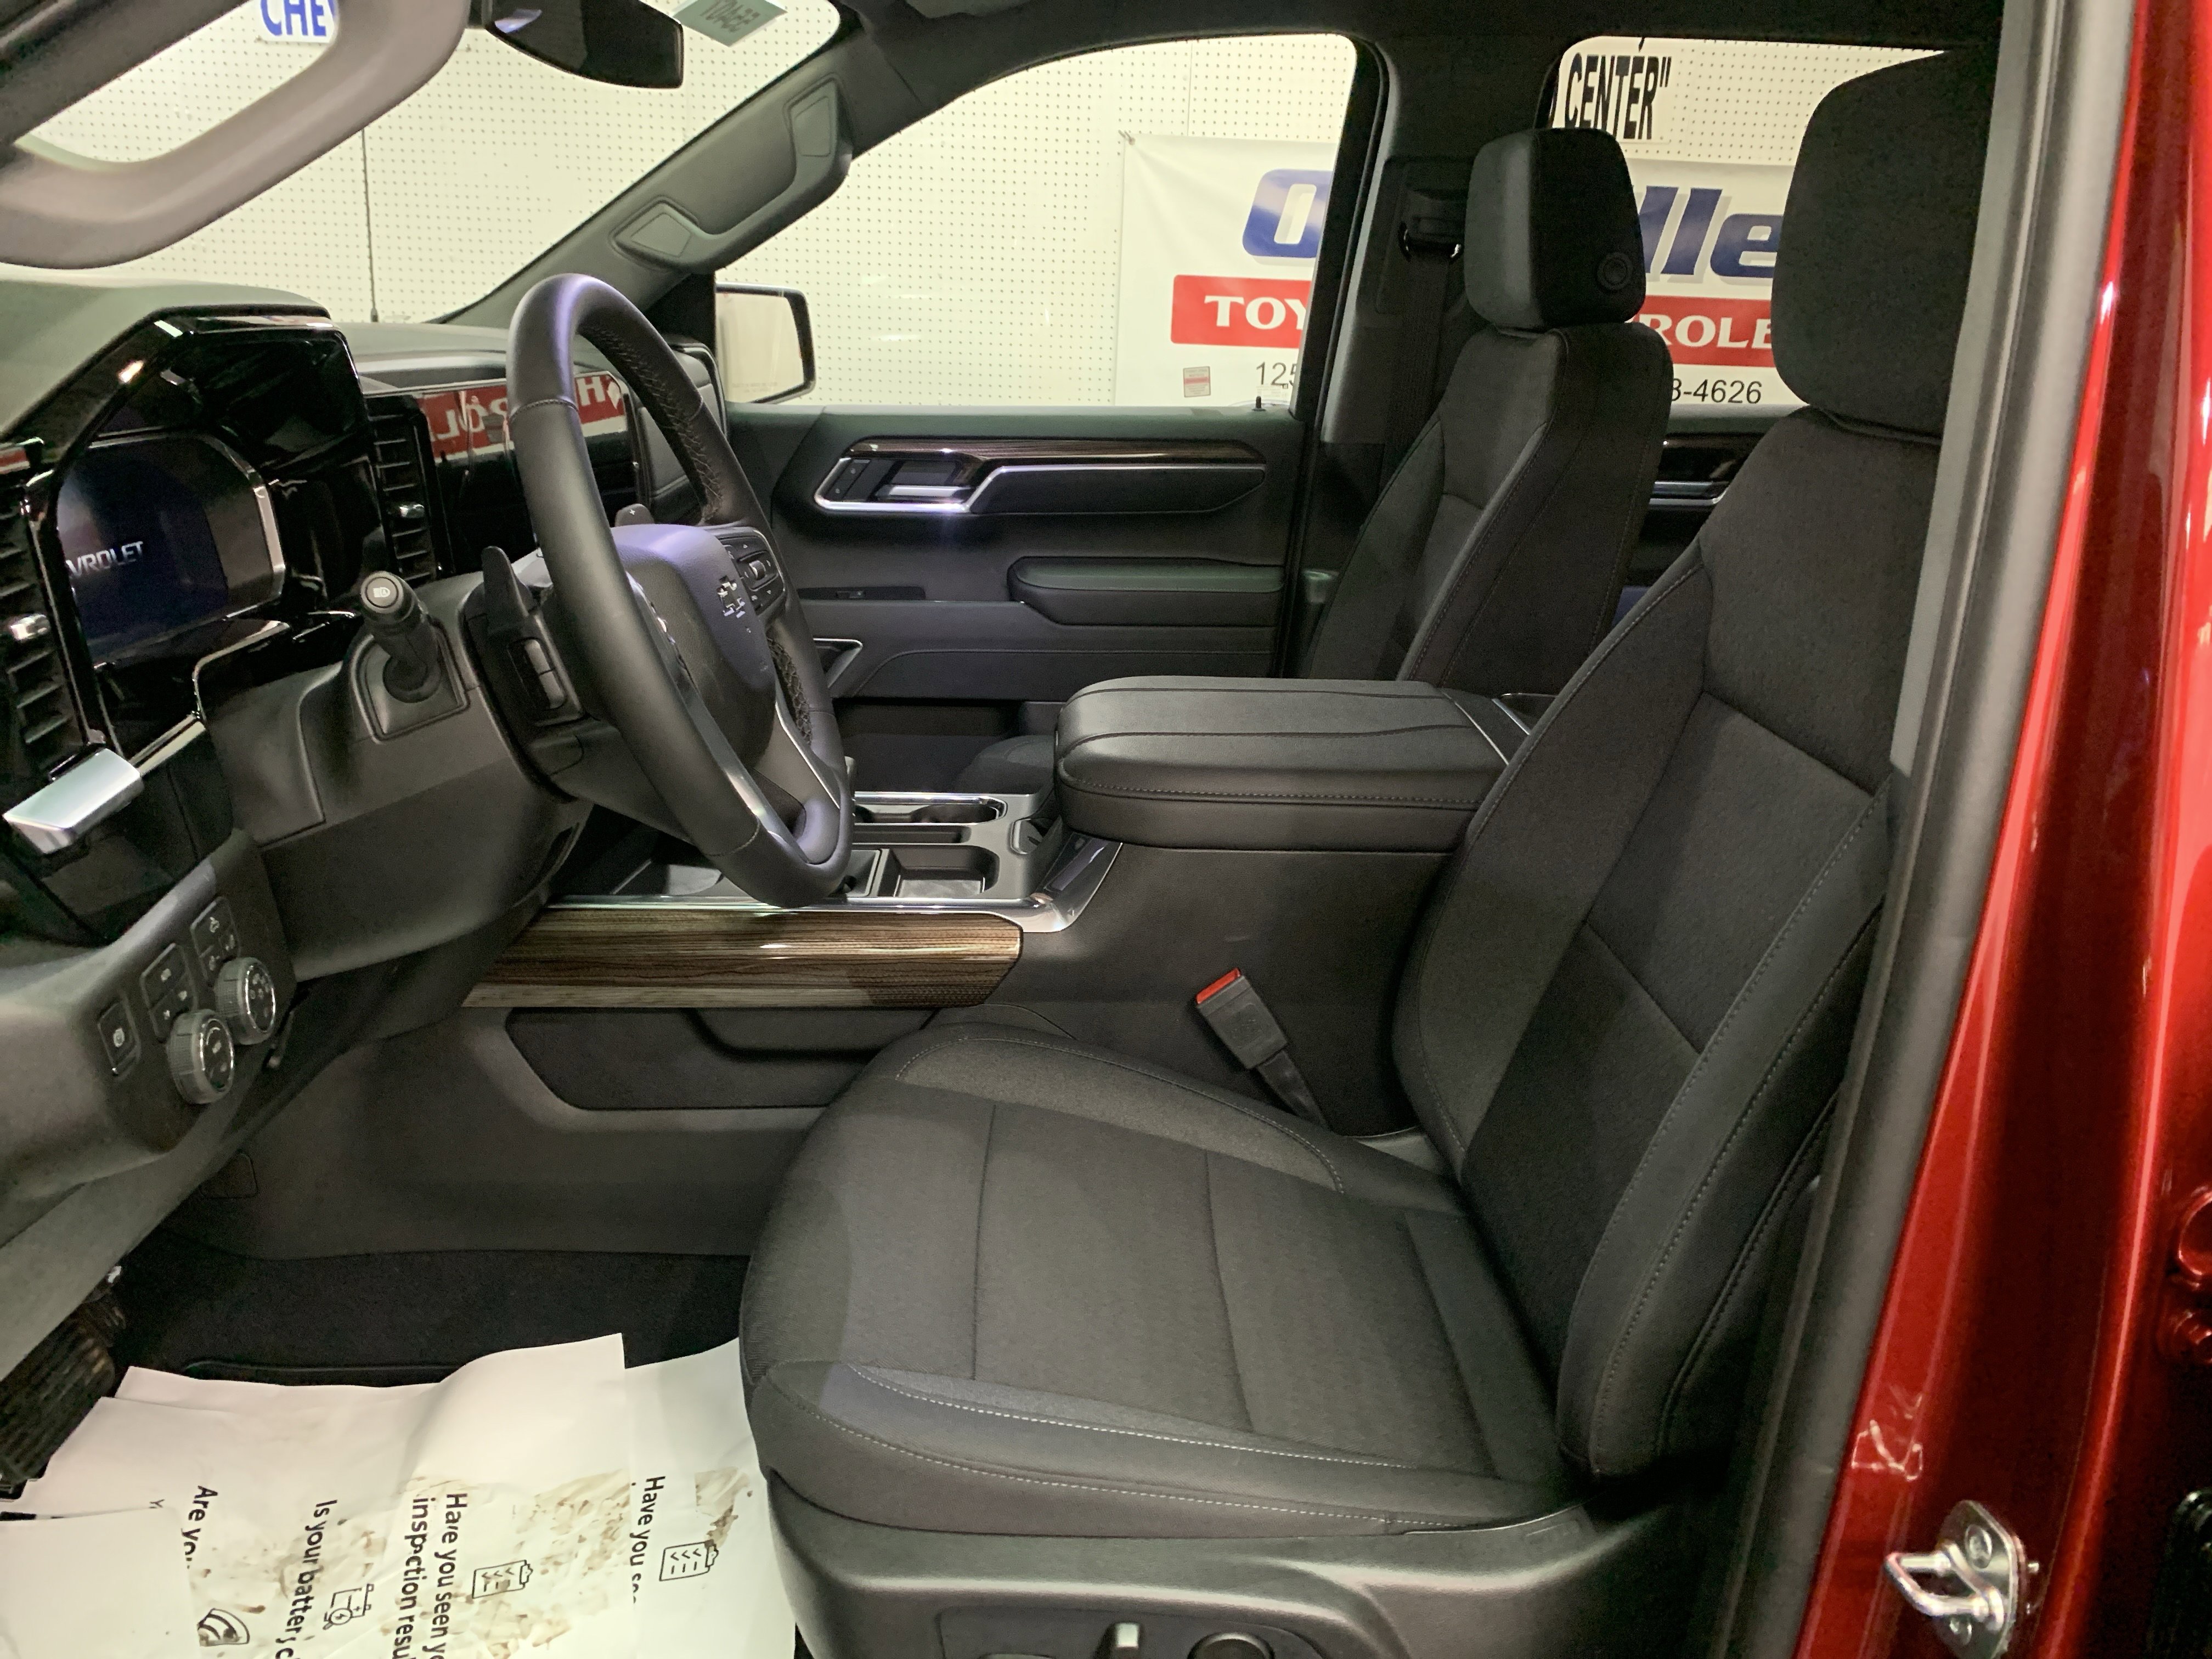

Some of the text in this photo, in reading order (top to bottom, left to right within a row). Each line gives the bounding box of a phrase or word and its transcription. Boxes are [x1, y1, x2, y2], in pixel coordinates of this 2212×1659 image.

[260, 0, 335, 36] CHE
[1638, 313, 1771, 349] ROLE
[65, 541, 144, 579] VROLET
[188, 1485, 218, 1521] Are
[313, 1499, 338, 1519] Is
[638, 1476, 666, 1526] Have
[303, 1520, 327, 1565] your
[630, 1530, 650, 1566] you
[435, 1549, 458, 1588] you
[430, 1592, 453, 1639] seen
